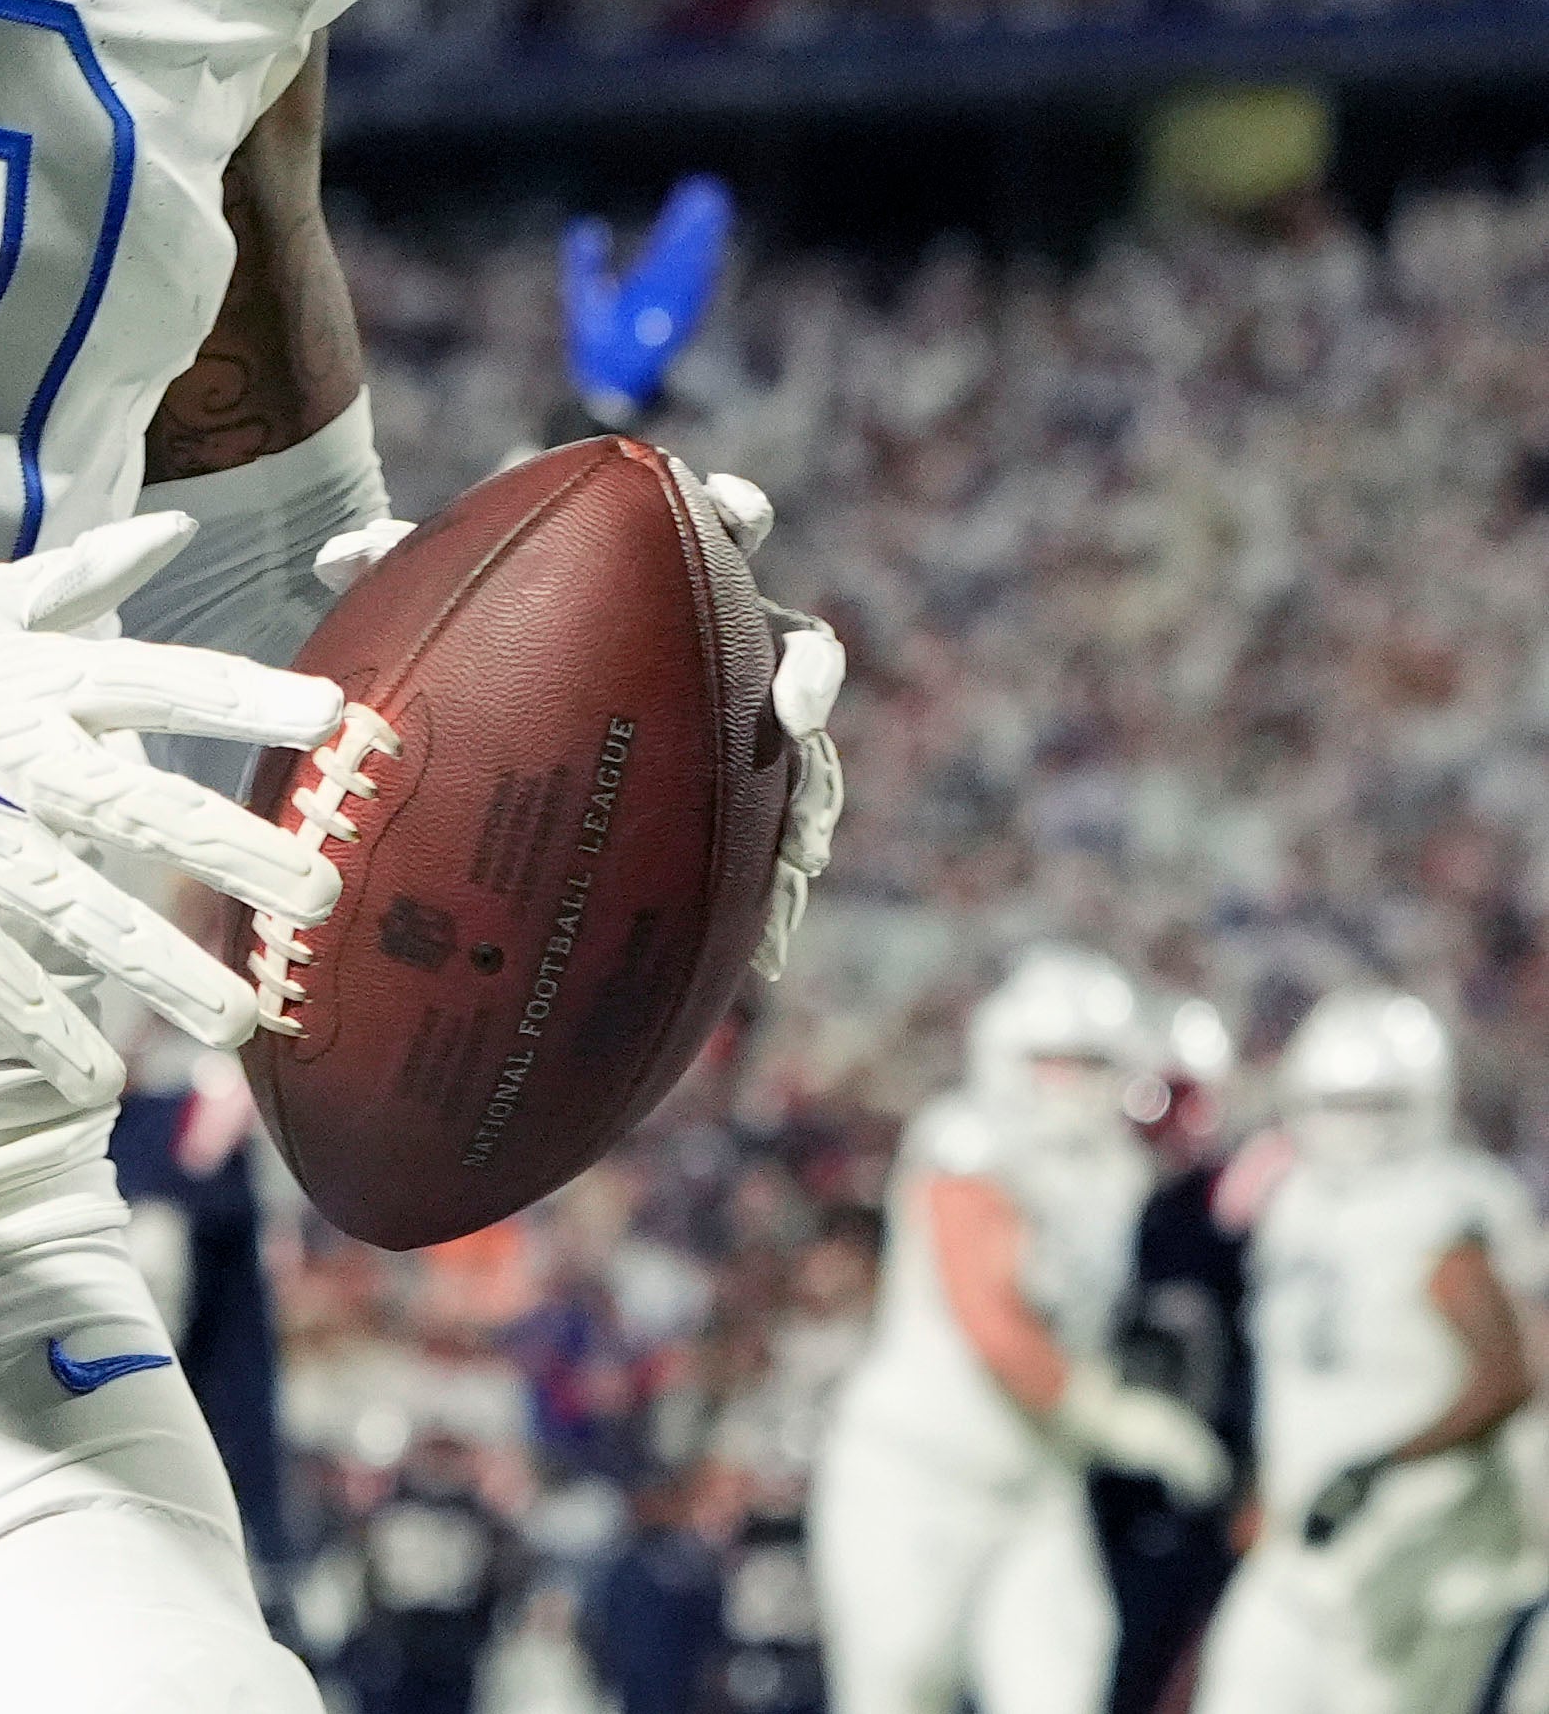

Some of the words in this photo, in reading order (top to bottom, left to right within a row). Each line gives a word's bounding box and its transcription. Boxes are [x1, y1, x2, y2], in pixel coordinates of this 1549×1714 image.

[461, 1046, 533, 1168] NATIONAL
[517, 864, 593, 1038] FOOTBALL
[578, 716, 634, 854] LEAGUE
